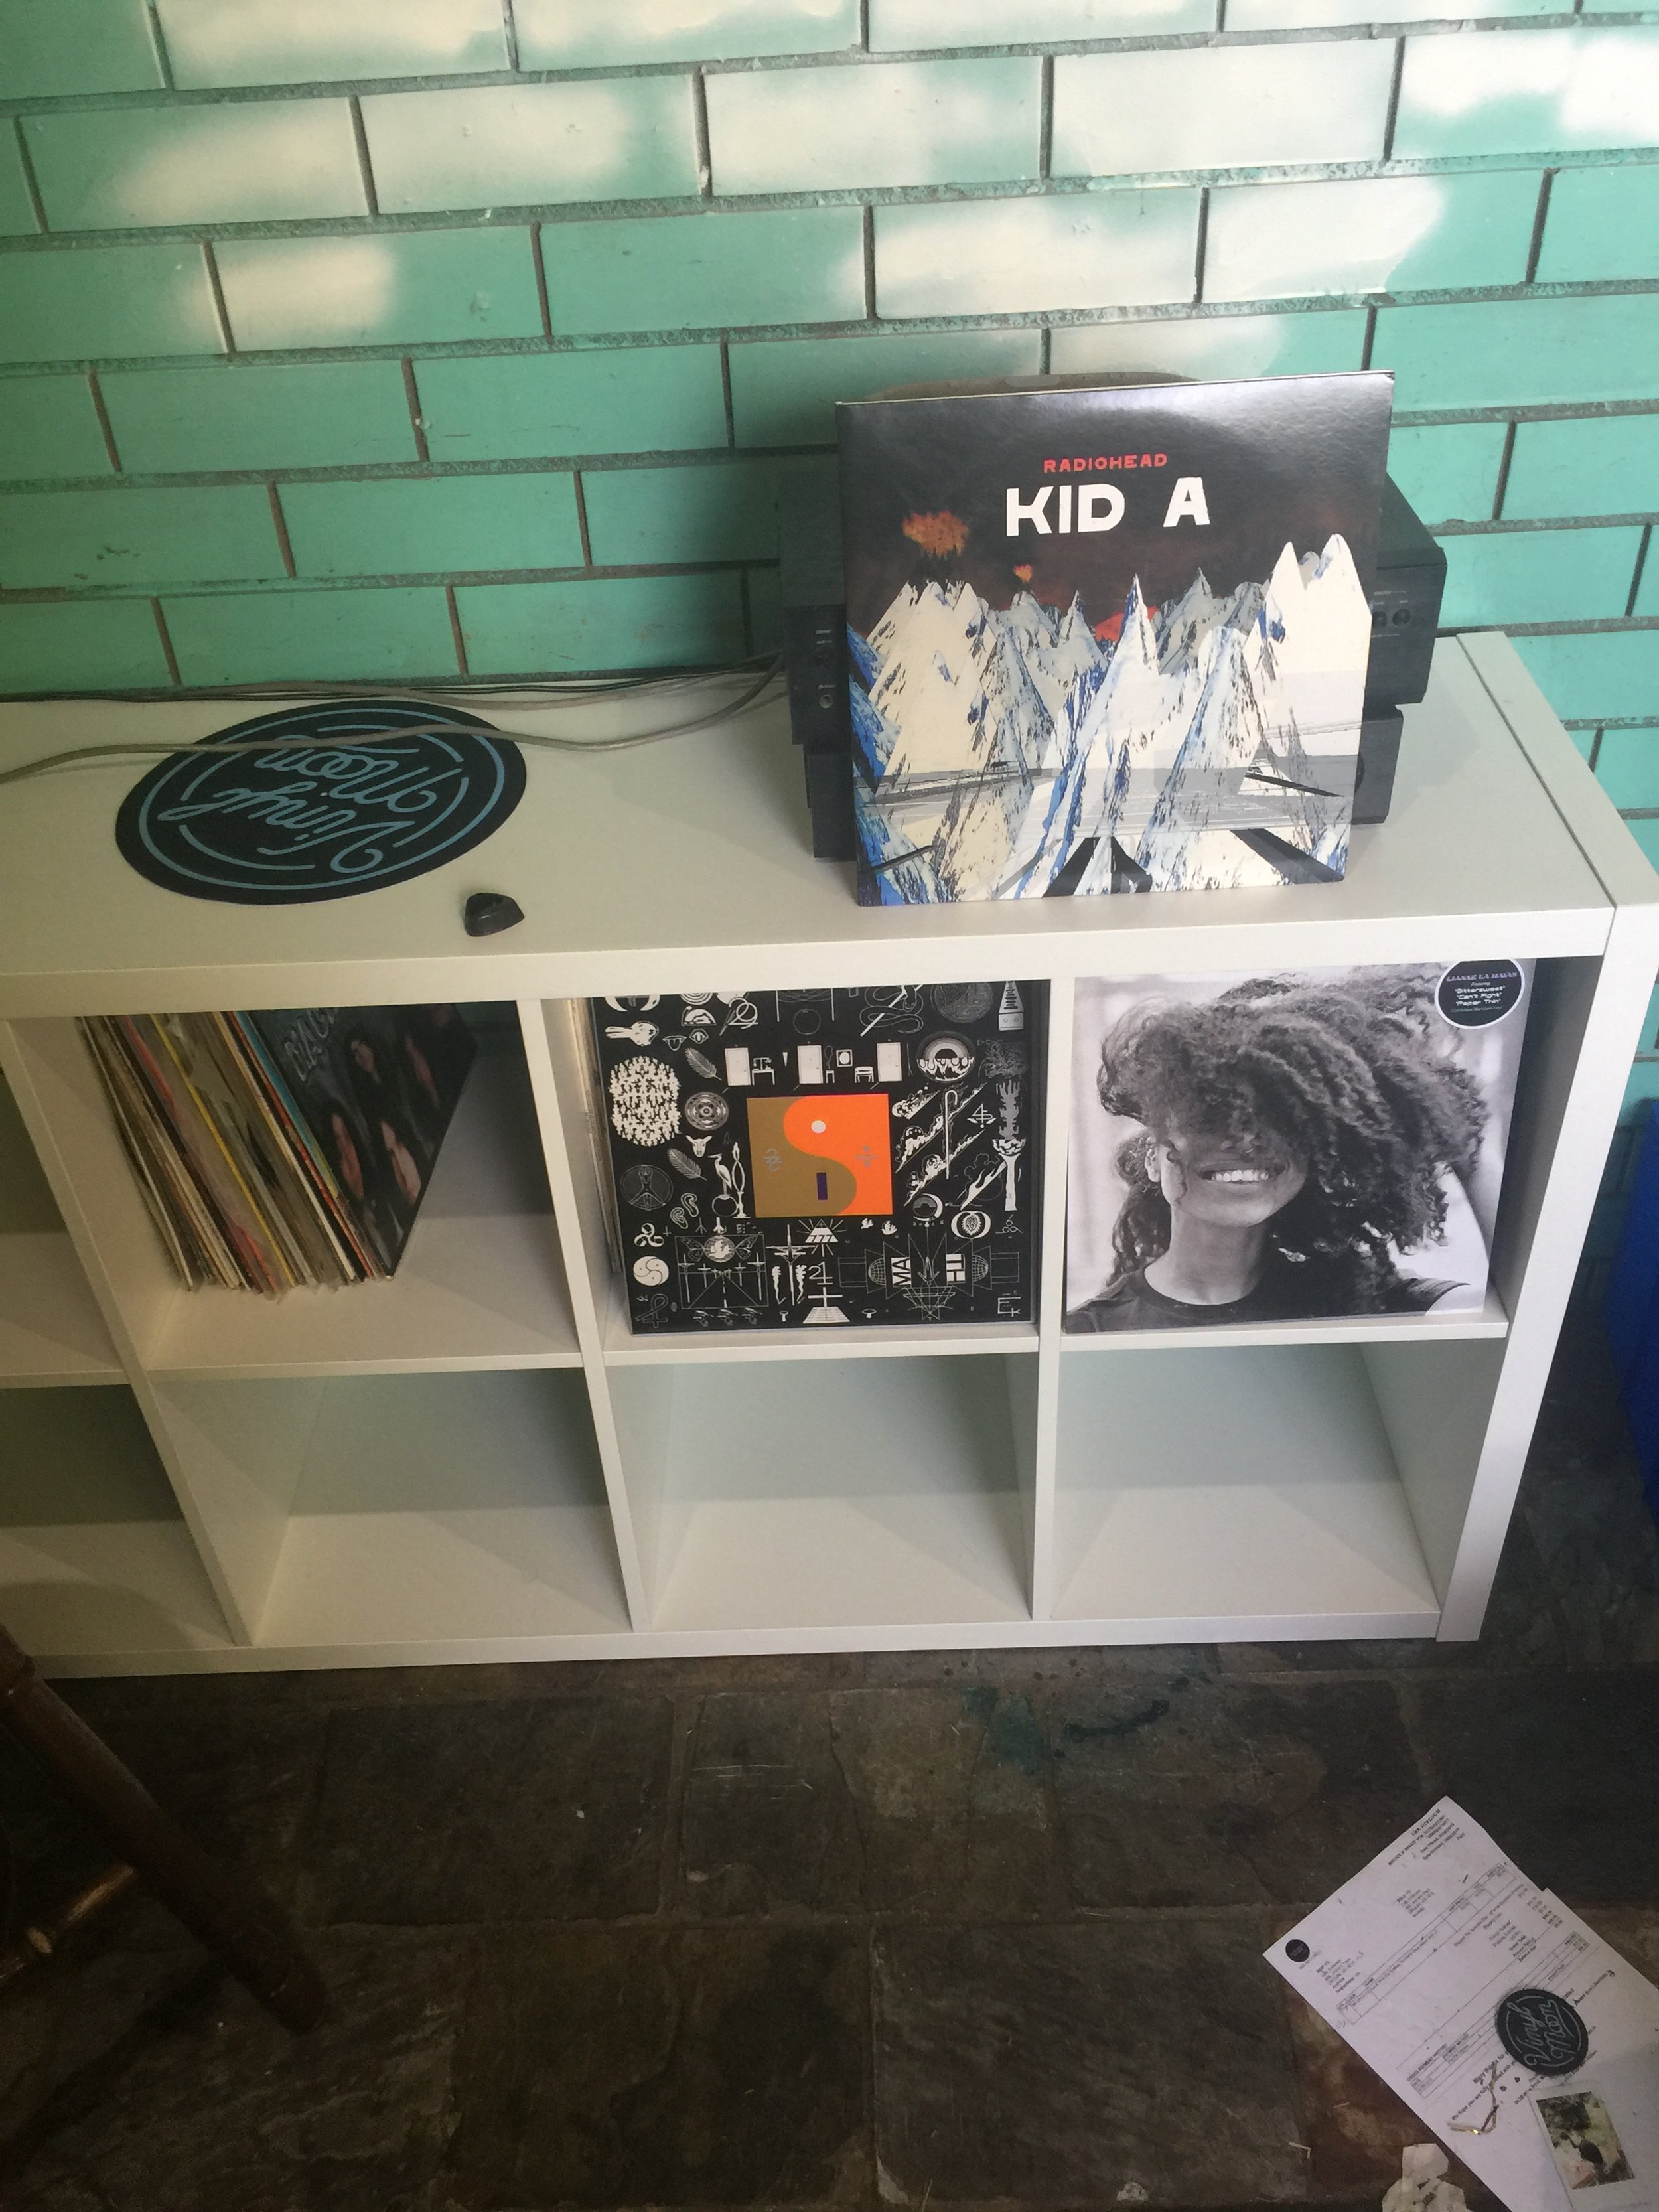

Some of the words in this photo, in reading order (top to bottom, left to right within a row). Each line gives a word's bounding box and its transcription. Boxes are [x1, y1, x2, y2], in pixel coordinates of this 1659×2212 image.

[1043, 453, 1167, 473] RADIOHEAD
[1006, 483, 1125, 536] KID
[1162, 477, 1210, 528] A
[1506, 2002, 1551, 2066] Vinyl
[1540, 1999, 1575, 2059] Moon
